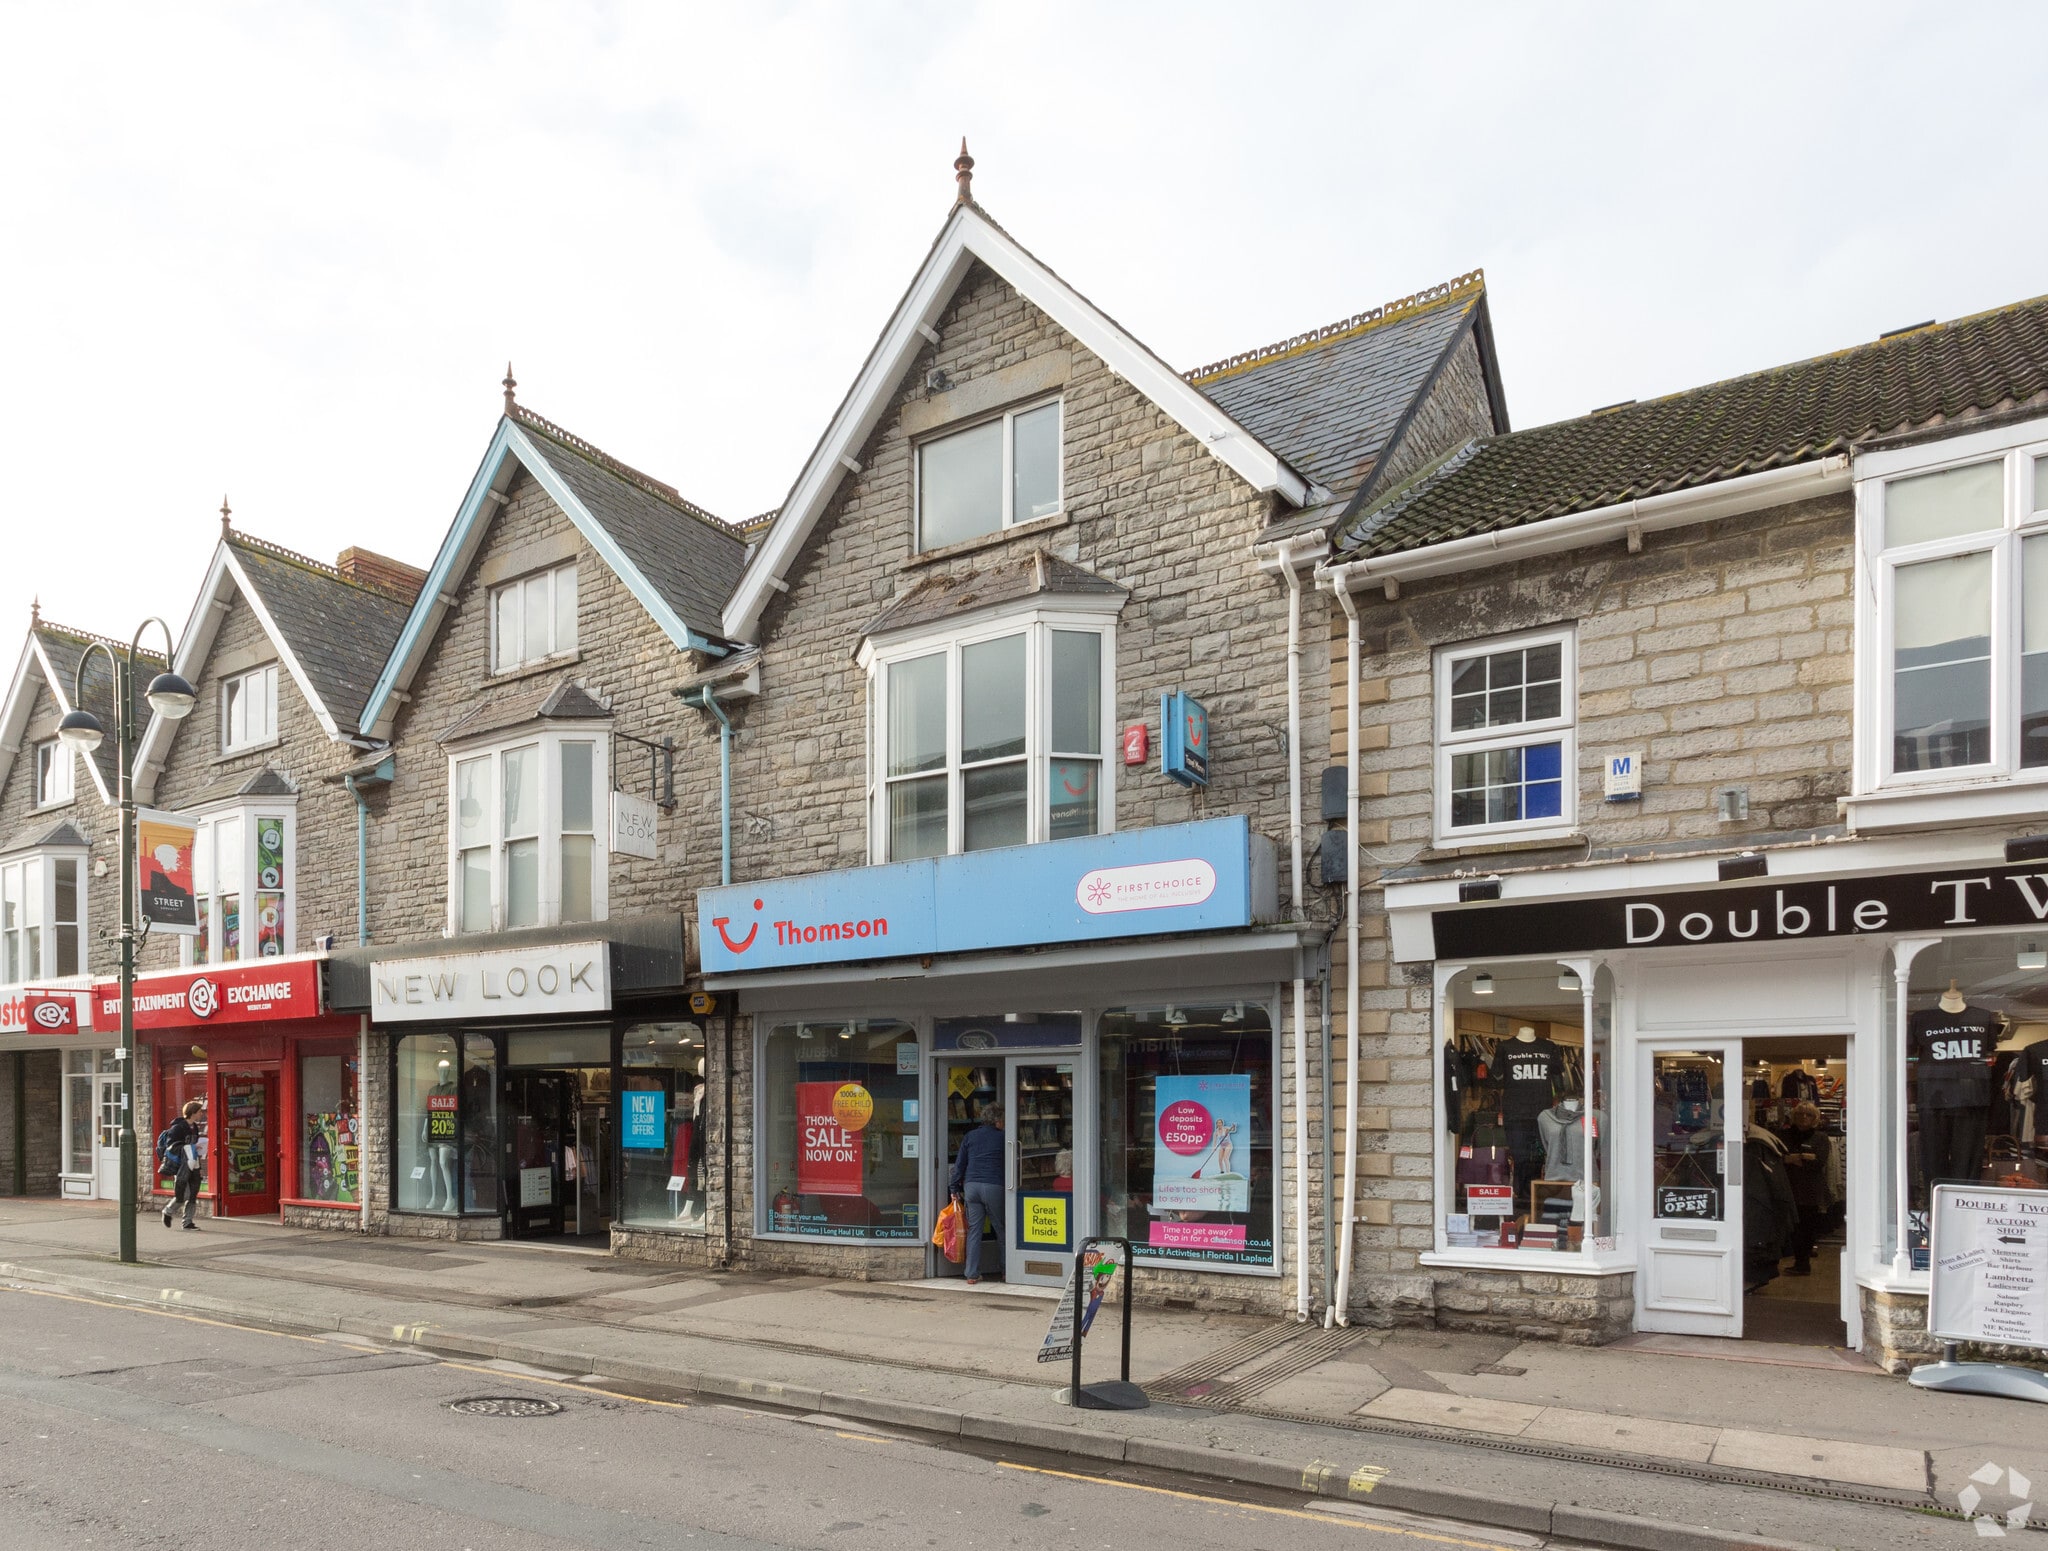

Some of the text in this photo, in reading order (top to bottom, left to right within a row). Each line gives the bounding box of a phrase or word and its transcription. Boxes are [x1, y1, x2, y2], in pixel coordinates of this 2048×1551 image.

[1612, 757, 1631, 776] M
[620, 811, 653, 828] NEW
[618, 823, 655, 841] LOOK
[1116, 876, 1202, 894] FIRST CHOICE
[153, 896, 185, 908] STREET
[1624, 885, 1889, 945] Double
[773, 917, 888, 946] Thomson
[377, 960, 595, 1006] NEW LOOK
[227, 981, 292, 1004] EXCHANGE
[1925, 1025, 1986, 1037] Double TWO
[1931, 1039, 1982, 1060] SALE
[1533, 1052, 1551, 1060] TWO
[1512, 1063, 1549, 1081] SALE
[431, 1098, 455, 1108] SALE
[631, 1095, 655, 1113] NEW
[833, 1099, 872, 1108] FREE CHILD
[431, 1111, 455, 1119] EXTRA
[1177, 1106, 1195, 1114] Low
[631, 1114, 655, 1124] SEASON
[1169, 1115, 1203, 1123] deposits
[431, 1119, 456, 1135] 20%
[631, 1124, 655, 1136] OFFERS
[1176, 1123, 1195, 1131] from
[805, 1127, 853, 1148] SALE
[240, 1153, 264, 1167] CASH
[805, 1149, 833, 1162] NOW
[1158, 1185, 1223, 1195] Life's too short
[1158, 1195, 1198, 1205] to say no
[1664, 1199, 1709, 1213] OPEN
[1954, 1198, 2008, 1212] DOUBLE
[1032, 1204, 1057, 1215] Great
[773, 1212, 828, 1222] Discover your smile
[1032, 1215, 1058, 1226] Rates
[1986, 1217, 2038, 1227] FACTORY
[774, 1224, 914, 1238] Beaches Cruises Long Haul UK City Breaks
[1031, 1226, 1058, 1237] Inside
[1162, 1225, 1181, 1234] Time
[1192, 1227, 1207, 1236] get
[1208, 1228, 1234, 1237] away?
[1996, 1226, 2027, 1236] SHOP
[1164, 1233, 1180, 1243] Pop
[1181, 1234, 1189, 1242] in
[1190, 1234, 1202, 1243] for
[1131, 1245, 1273, 1264] Sports & Activities Florida Lapland
[1991, 1248, 2030, 1257] Menswear
[1999, 1256, 2021, 1264] Shirts
[1984, 1272, 2034, 1284] Lambretta
[1986, 1282, 2030, 1291] Ladieswear
[2000, 1307, 2032, 1317] Elegance
